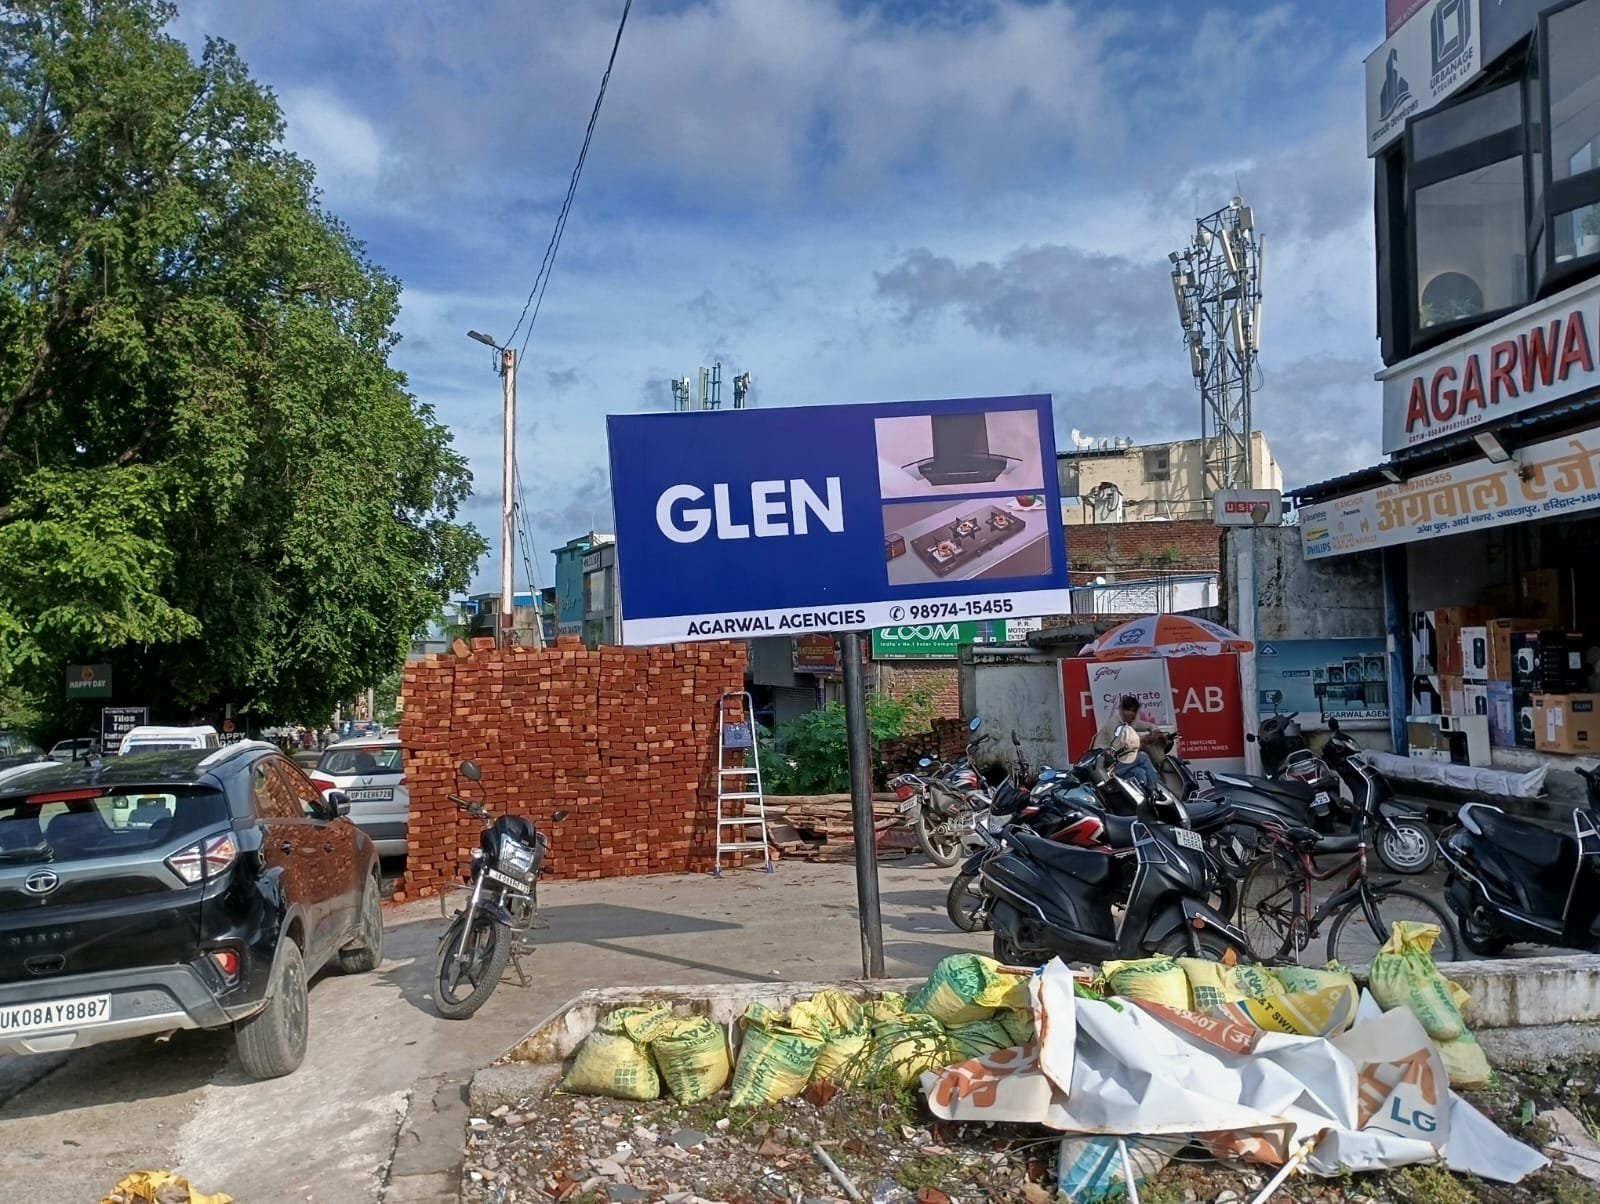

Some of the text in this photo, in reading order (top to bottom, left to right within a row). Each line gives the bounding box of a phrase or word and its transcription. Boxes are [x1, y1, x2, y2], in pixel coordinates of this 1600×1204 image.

[1430, 46, 1473, 89] URBANAGE
[1433, 62, 1471, 97] ATELIER LLP
[1404, 305, 1600, 433] AGARWA
[1376, 439, 1600, 533] अग्रवाल एजे
[655, 476, 845, 543] GLEN
[1306, 542, 1332, 556] PHILIPS
[687, 598, 1014, 636] AGARWAL AGENCIES 98974-15455
[69, 679, 106, 689] HAPPY DAY
[1093, 666, 1122, 682] Godrej
[1365, 710, 1389, 718] AGEN
[219, 732, 246, 740] APPY
[0, 999, 108, 1029] UK08AY8887
[1272, 1012, 1300, 1035] SWIT
[1390, 1096, 1437, 1133] LG
